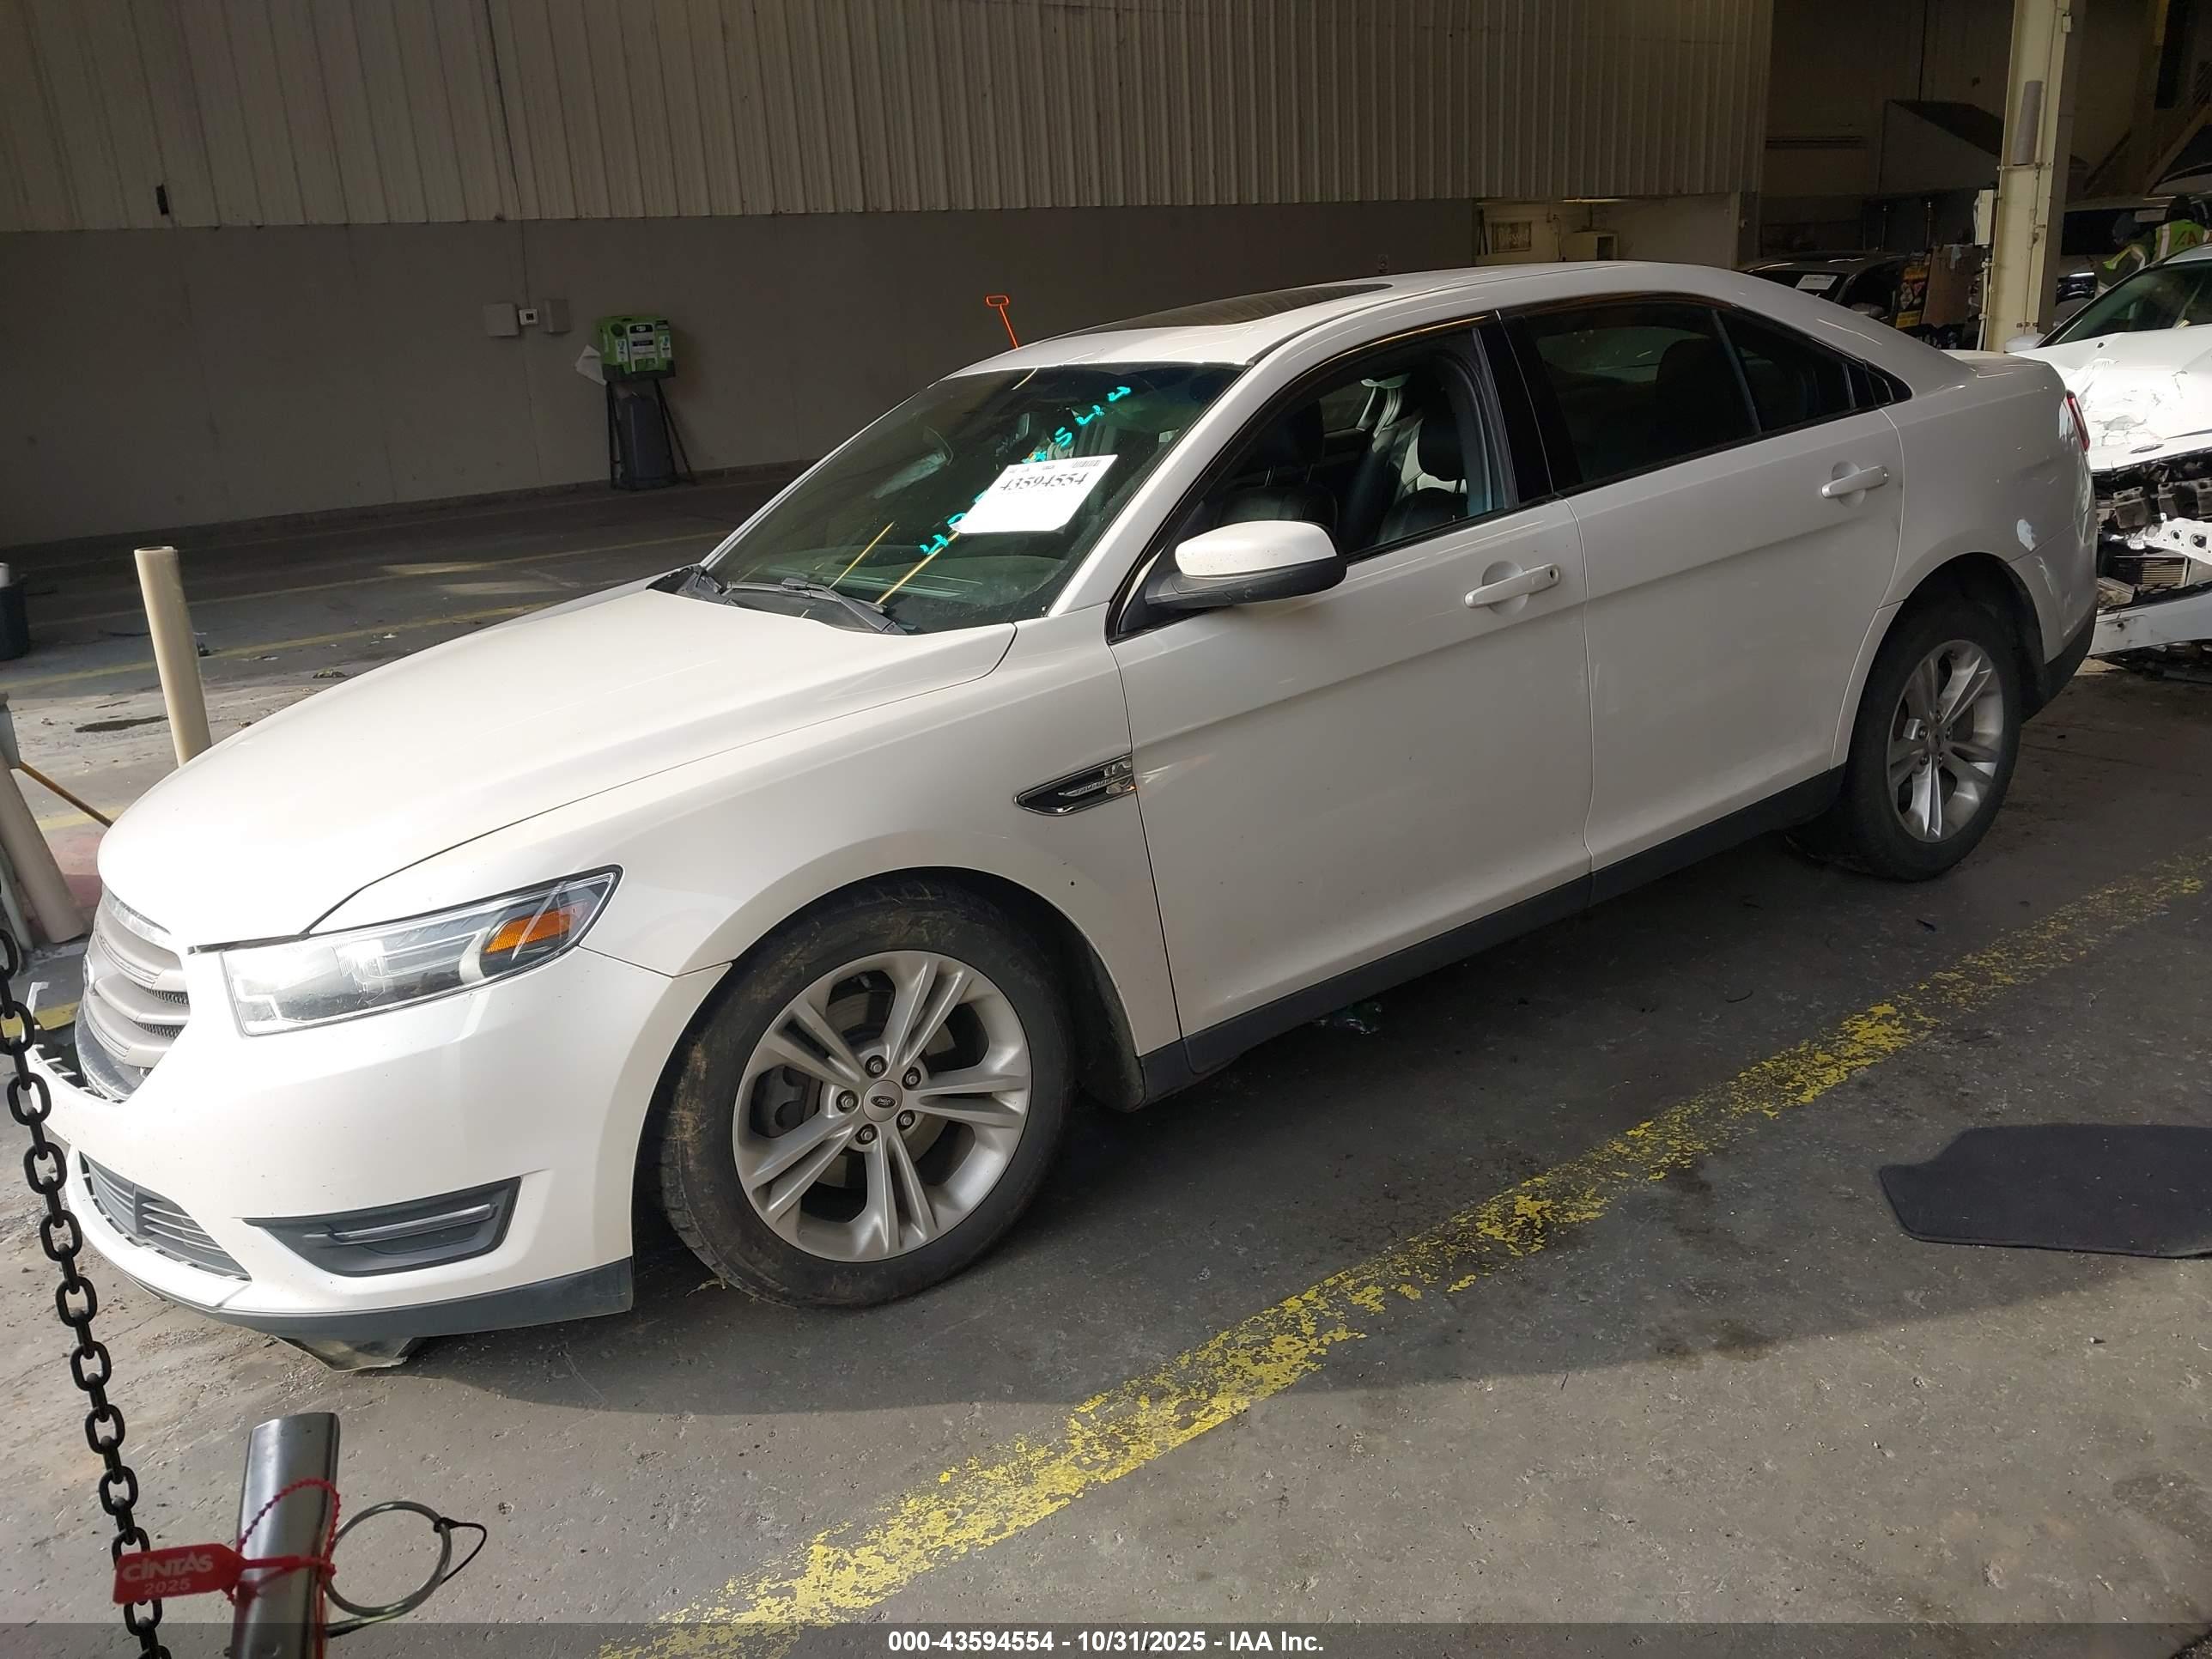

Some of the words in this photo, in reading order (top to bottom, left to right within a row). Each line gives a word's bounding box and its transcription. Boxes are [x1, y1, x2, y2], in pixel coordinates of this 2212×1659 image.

[1000, 472, 1089, 491] 43594554
[121, 1552, 214, 1582] CINTAS
[144, 1578, 191, 1595] 2025
